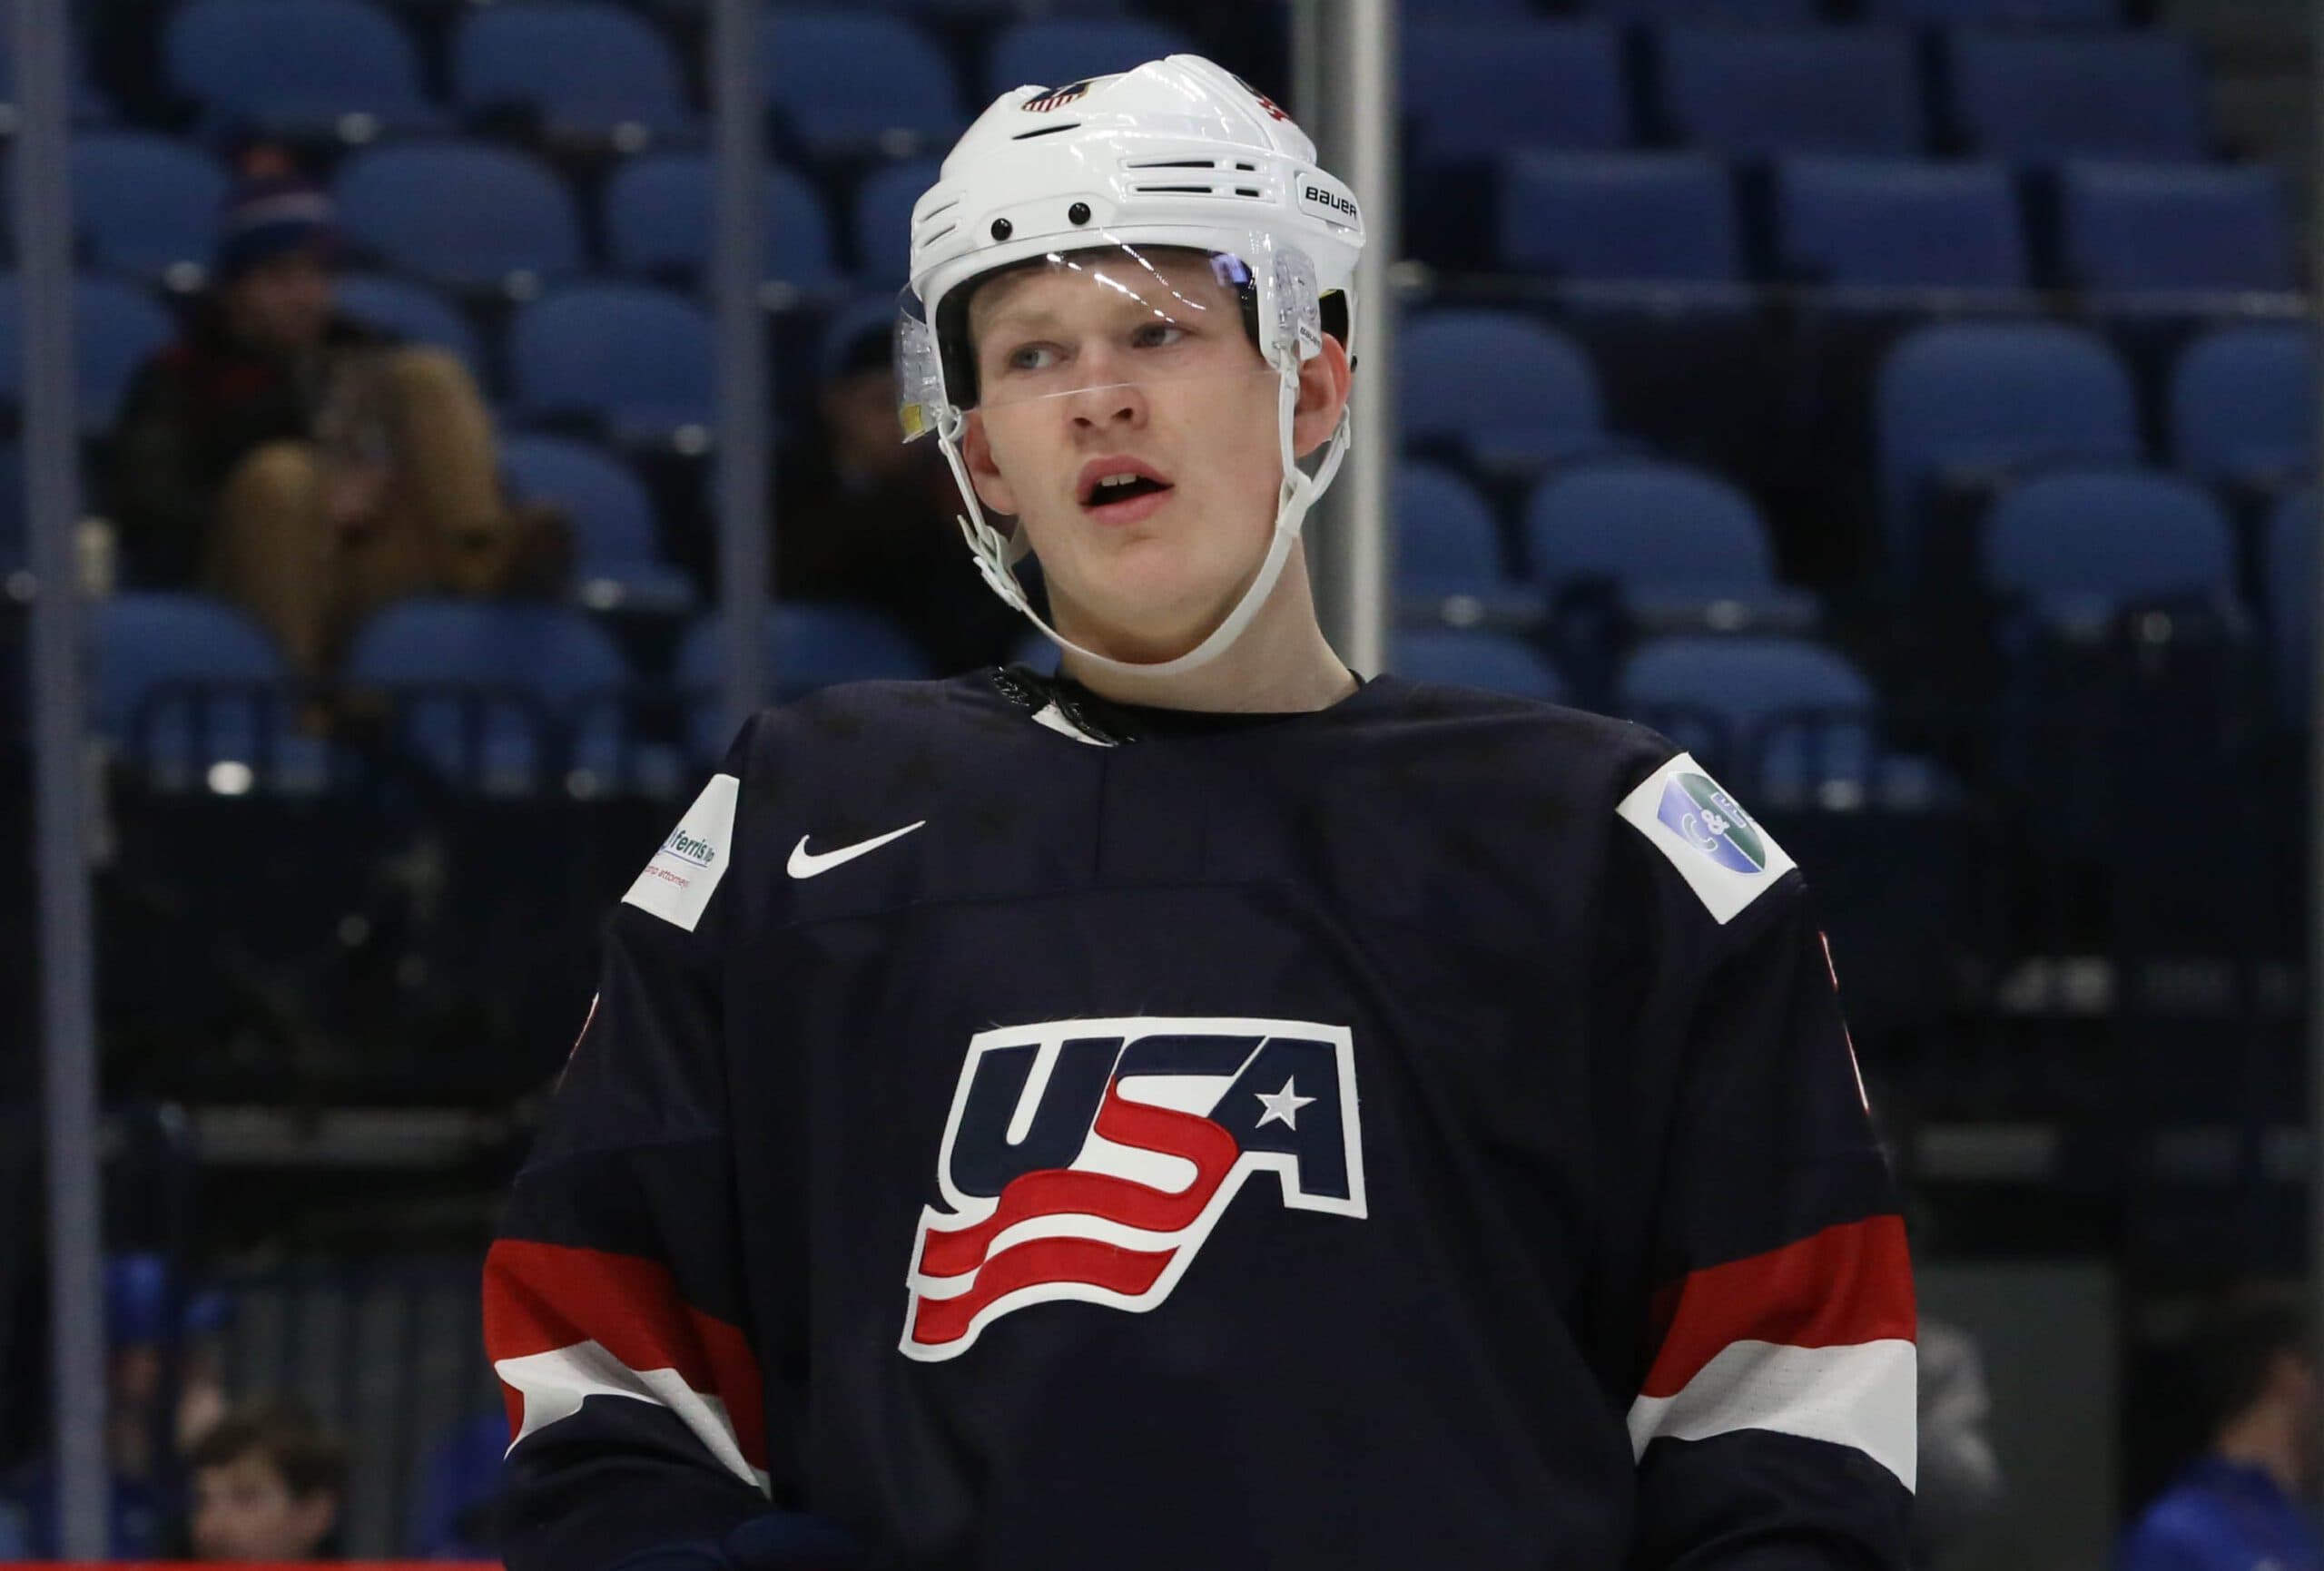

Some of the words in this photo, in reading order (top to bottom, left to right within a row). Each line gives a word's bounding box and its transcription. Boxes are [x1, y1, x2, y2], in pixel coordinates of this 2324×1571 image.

[1305, 185, 1358, 221] BAUER
[670, 830, 707, 859] ferris
[1682, 813, 1718, 851] C
[1701, 809, 1730, 835] &
[938, 1016, 1368, 1234] USA
